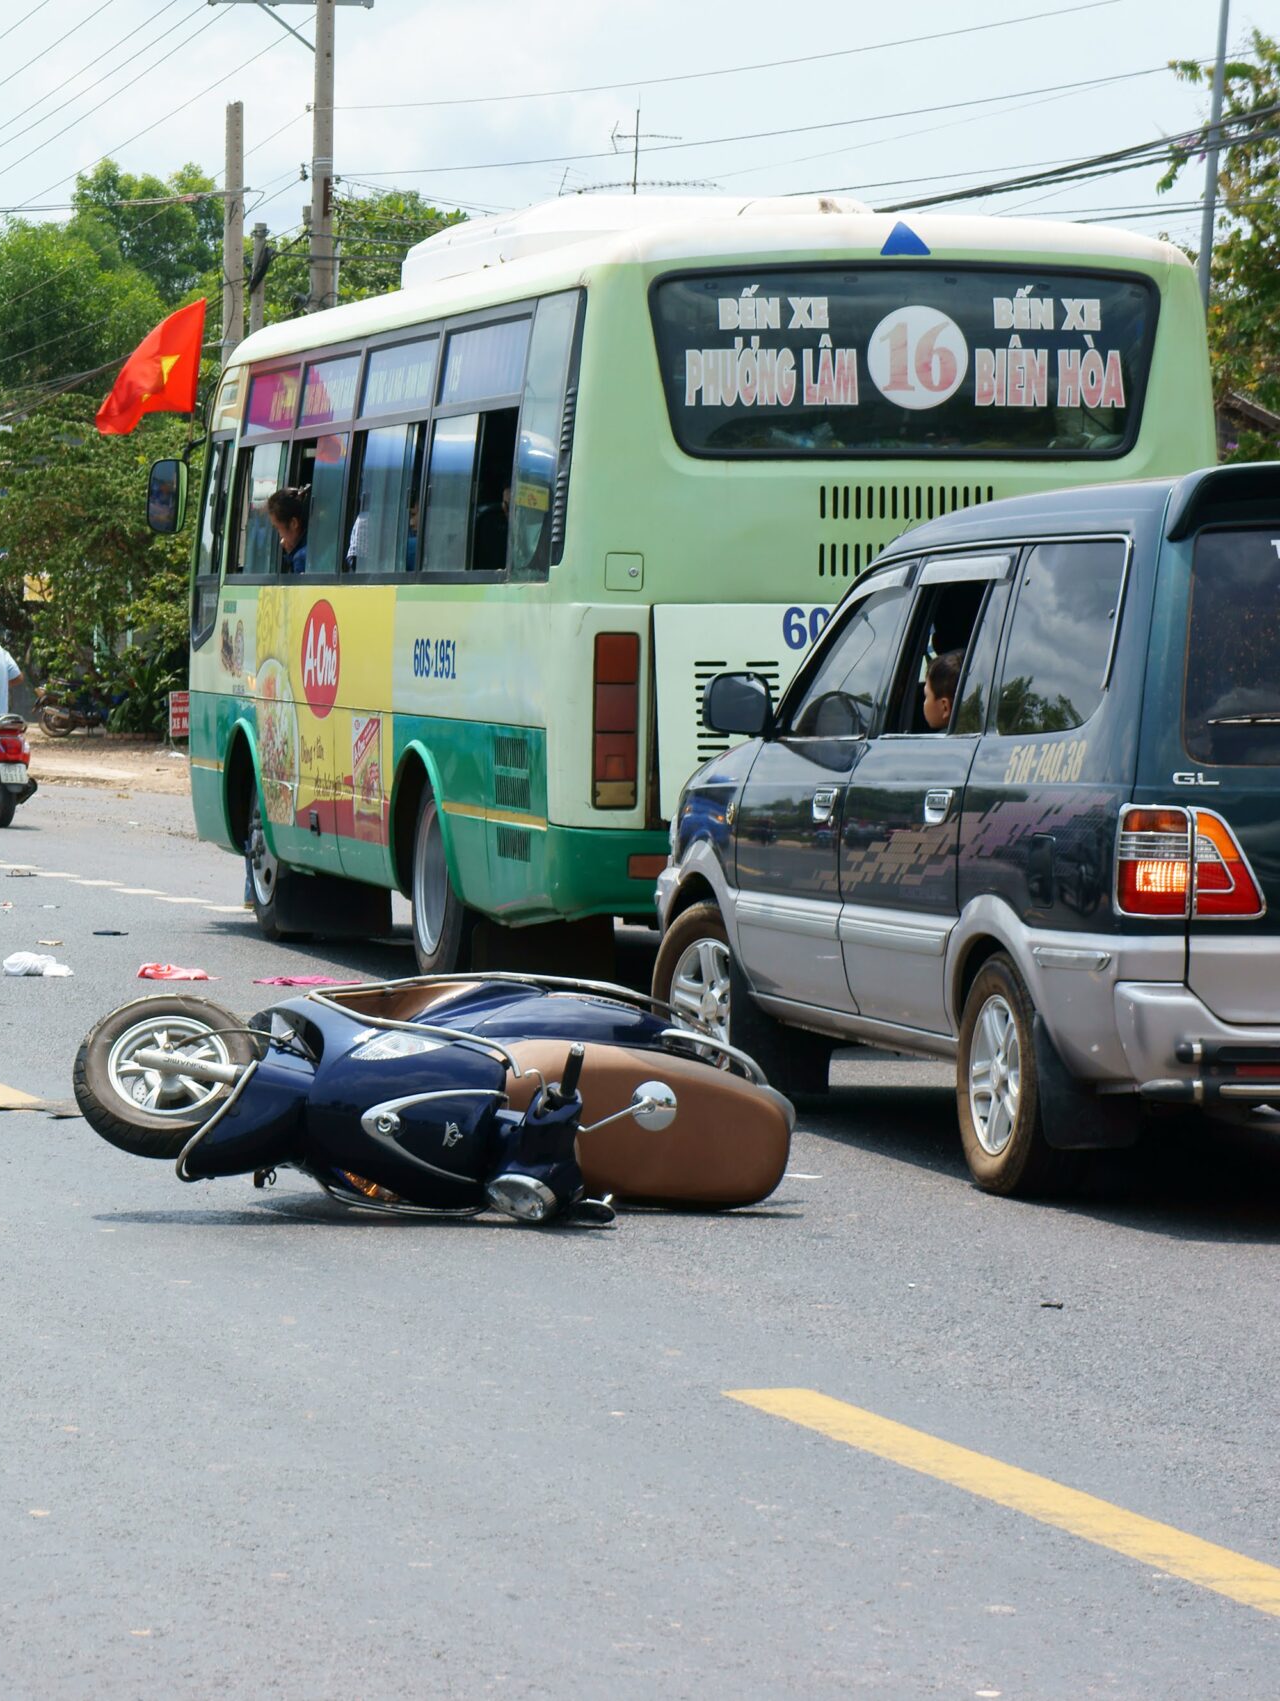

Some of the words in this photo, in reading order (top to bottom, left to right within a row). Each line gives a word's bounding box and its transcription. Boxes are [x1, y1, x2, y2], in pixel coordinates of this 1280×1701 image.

[718, 285, 780, 330] BẾN
[788, 297, 829, 330] XE
[993, 285, 1054, 331] BẾN
[1061, 298, 1102, 331] XE
[803, 333, 859, 406] LÂM
[879, 321, 959, 393] 16
[974, 334, 1048, 407] BIÊN
[1057, 334, 1126, 409] HÒA
[1172, 772, 1220, 786] GL
